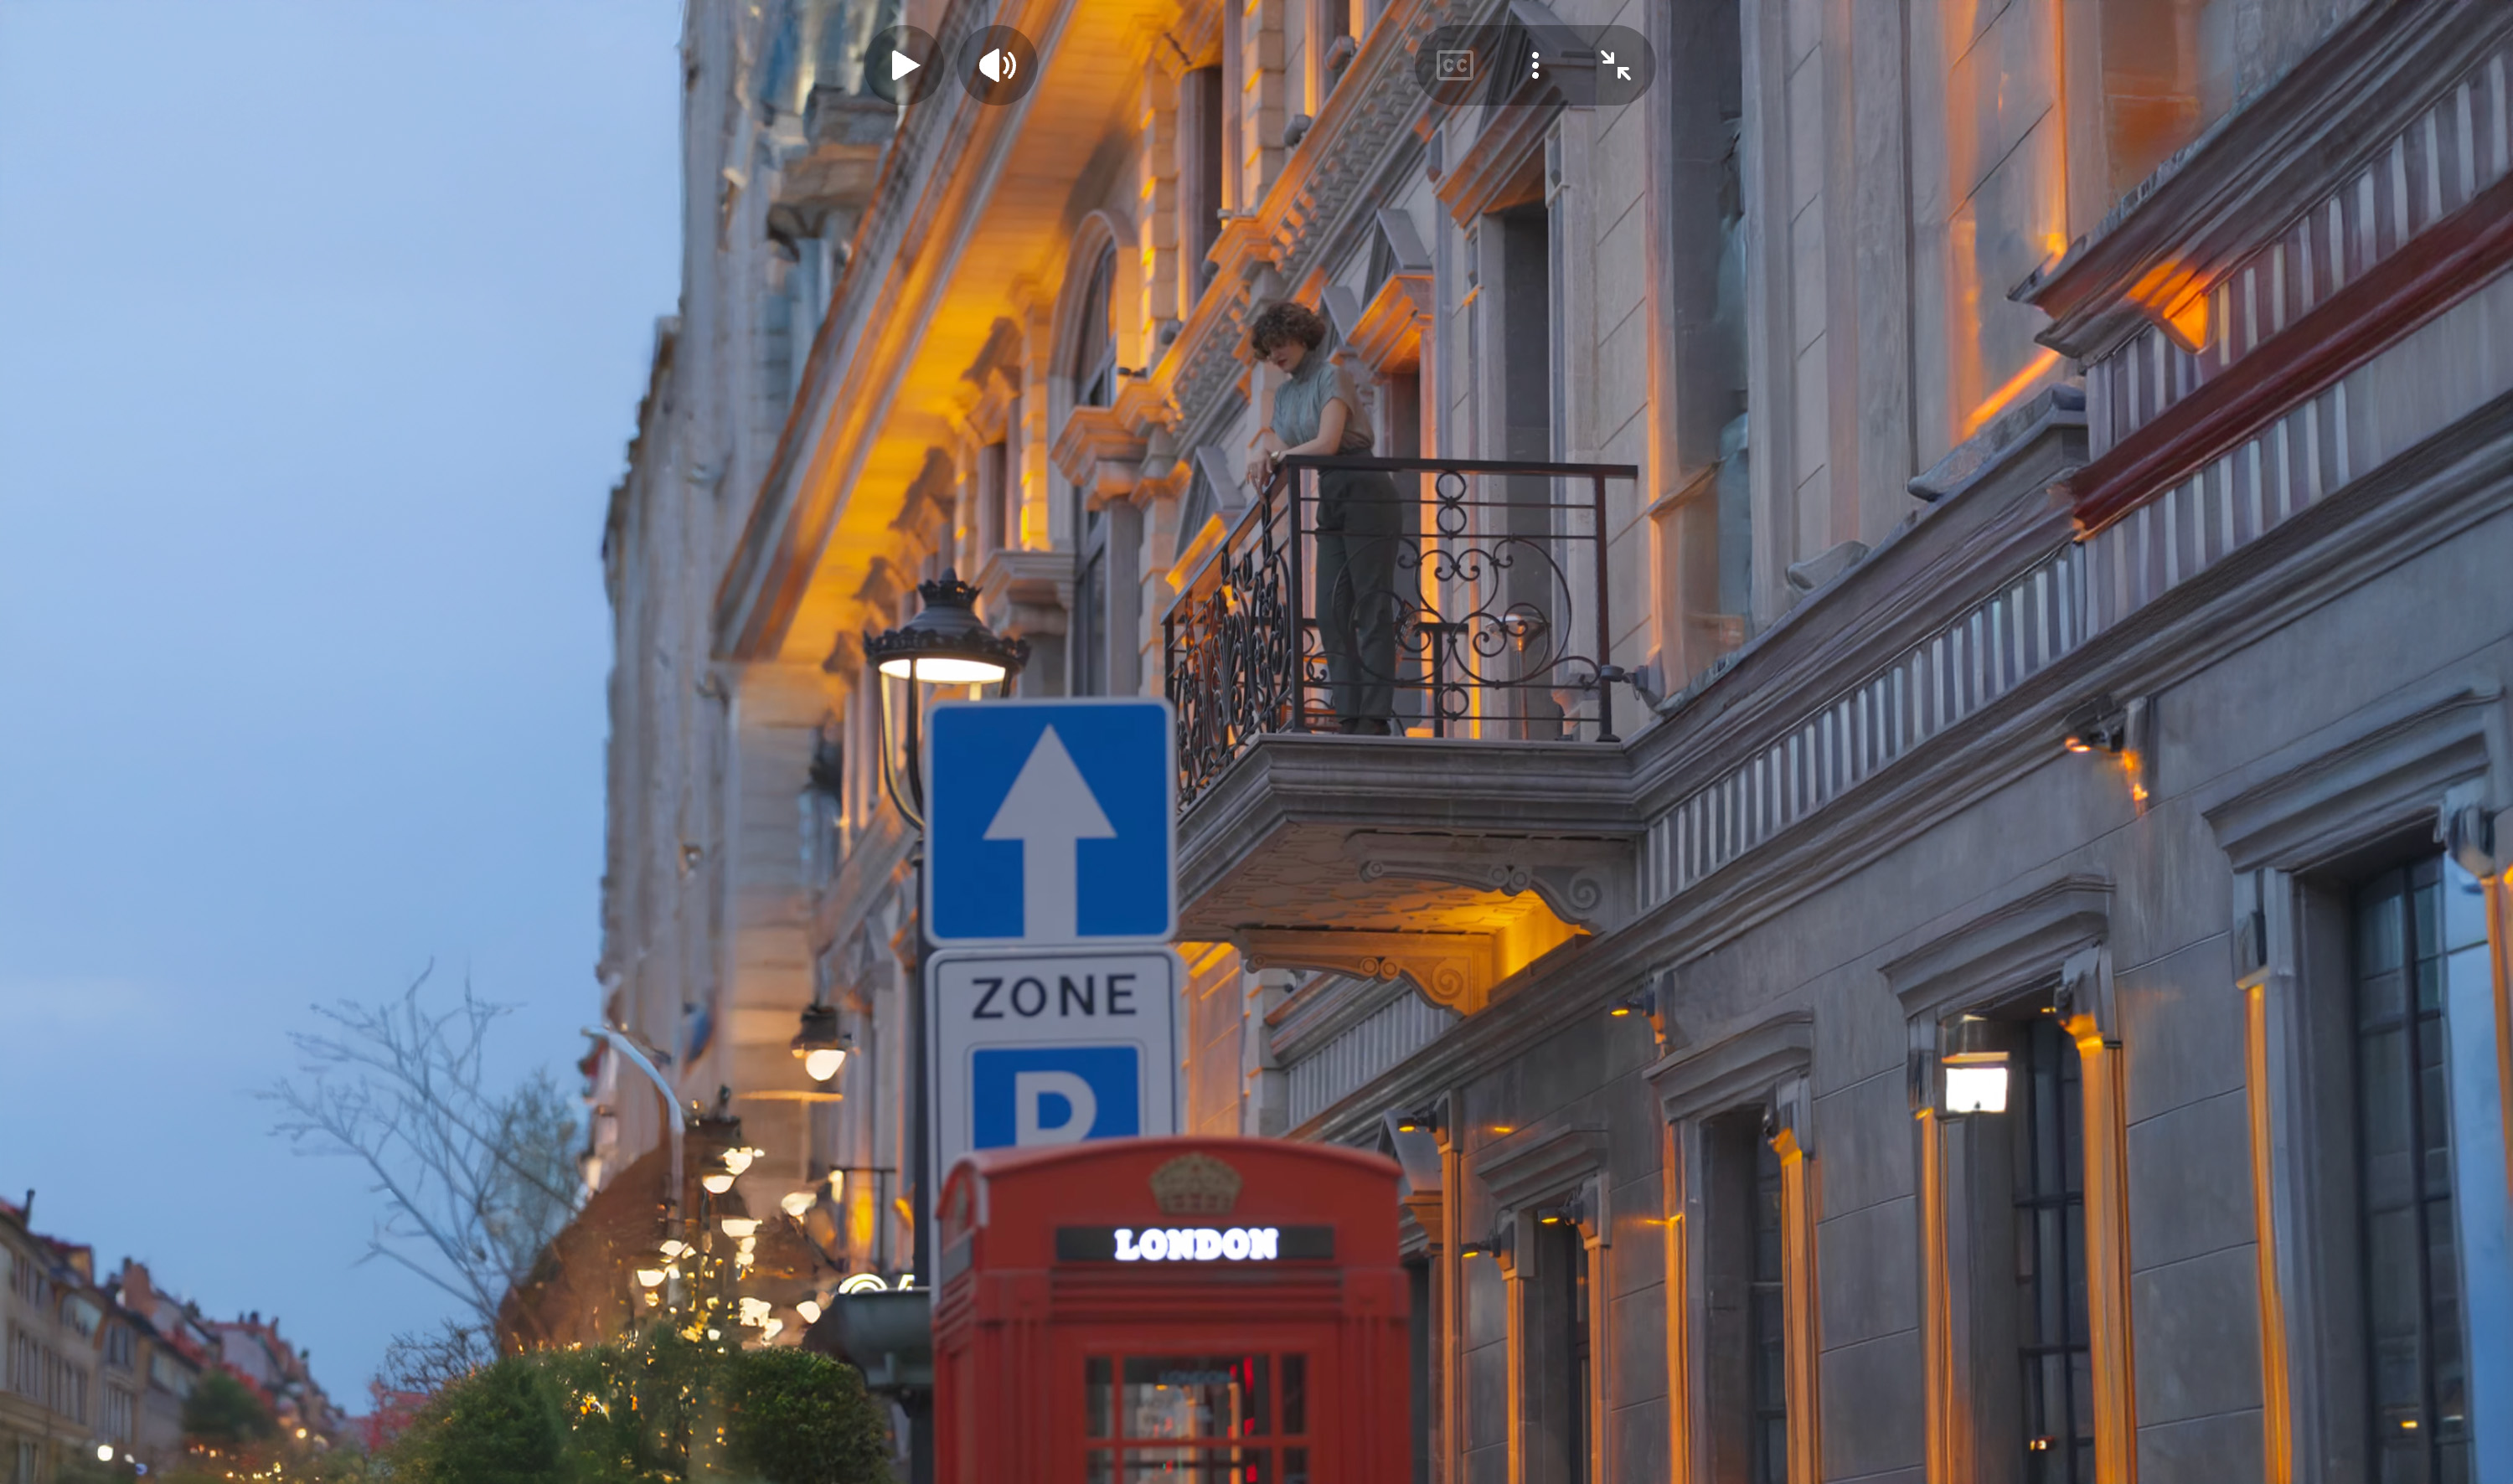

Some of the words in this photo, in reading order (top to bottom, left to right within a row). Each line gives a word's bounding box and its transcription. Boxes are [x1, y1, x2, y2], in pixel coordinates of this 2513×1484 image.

[972, 973, 1137, 1019] ZONE
[1014, 1069, 1097, 1147] P
[1113, 1227, 1279, 1261] LONDON
